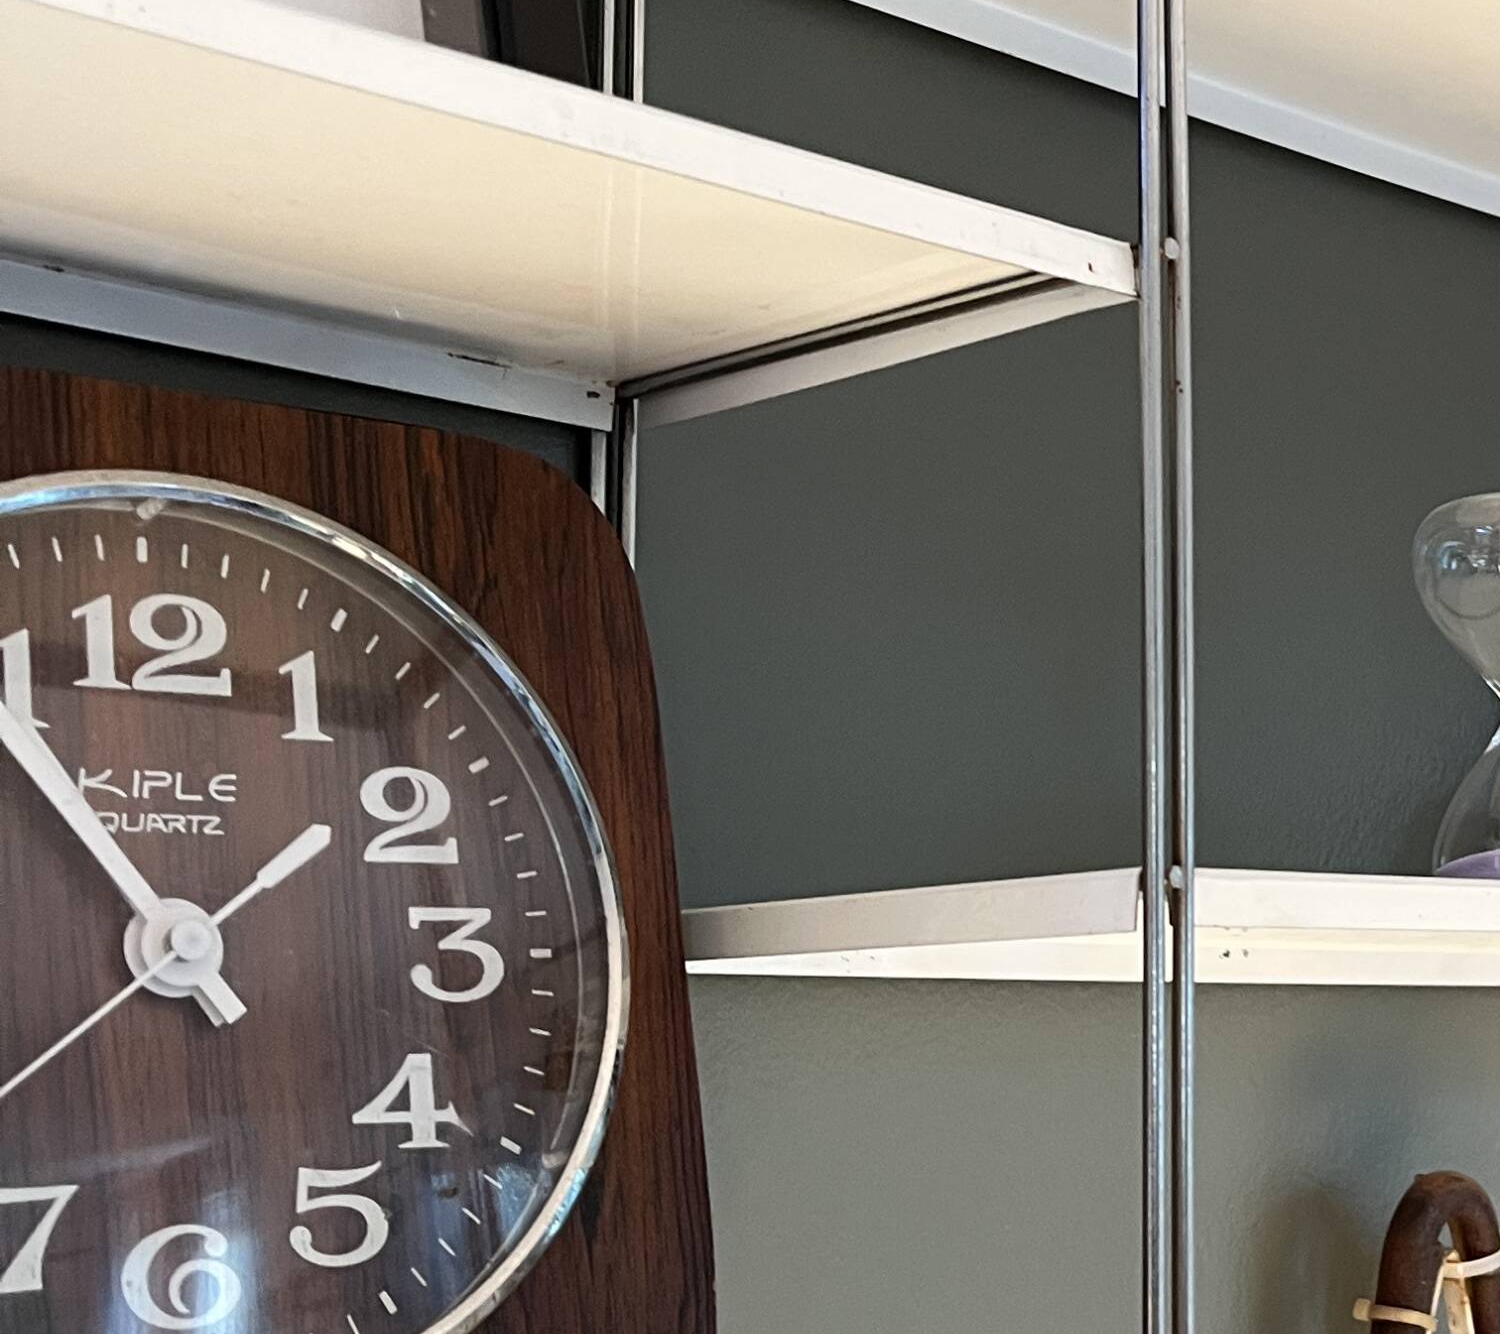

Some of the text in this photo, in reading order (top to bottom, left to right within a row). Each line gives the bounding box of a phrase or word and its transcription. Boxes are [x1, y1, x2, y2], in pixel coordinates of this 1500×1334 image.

[0, 628, 50, 729] 1
[71, 593, 232, 696] 12
[278, 650, 334, 742] 1
[78, 767, 237, 802] KIPLE
[95, 811, 225, 836] QUARTZ
[359, 765, 459, 864] 2
[408, 906, 504, 1003] 3
[352, 1053, 474, 1148] 4
[0, 1185, 79, 1294] 7
[289, 1161, 389, 1267] 5
[121, 1223, 241, 1330] 6
